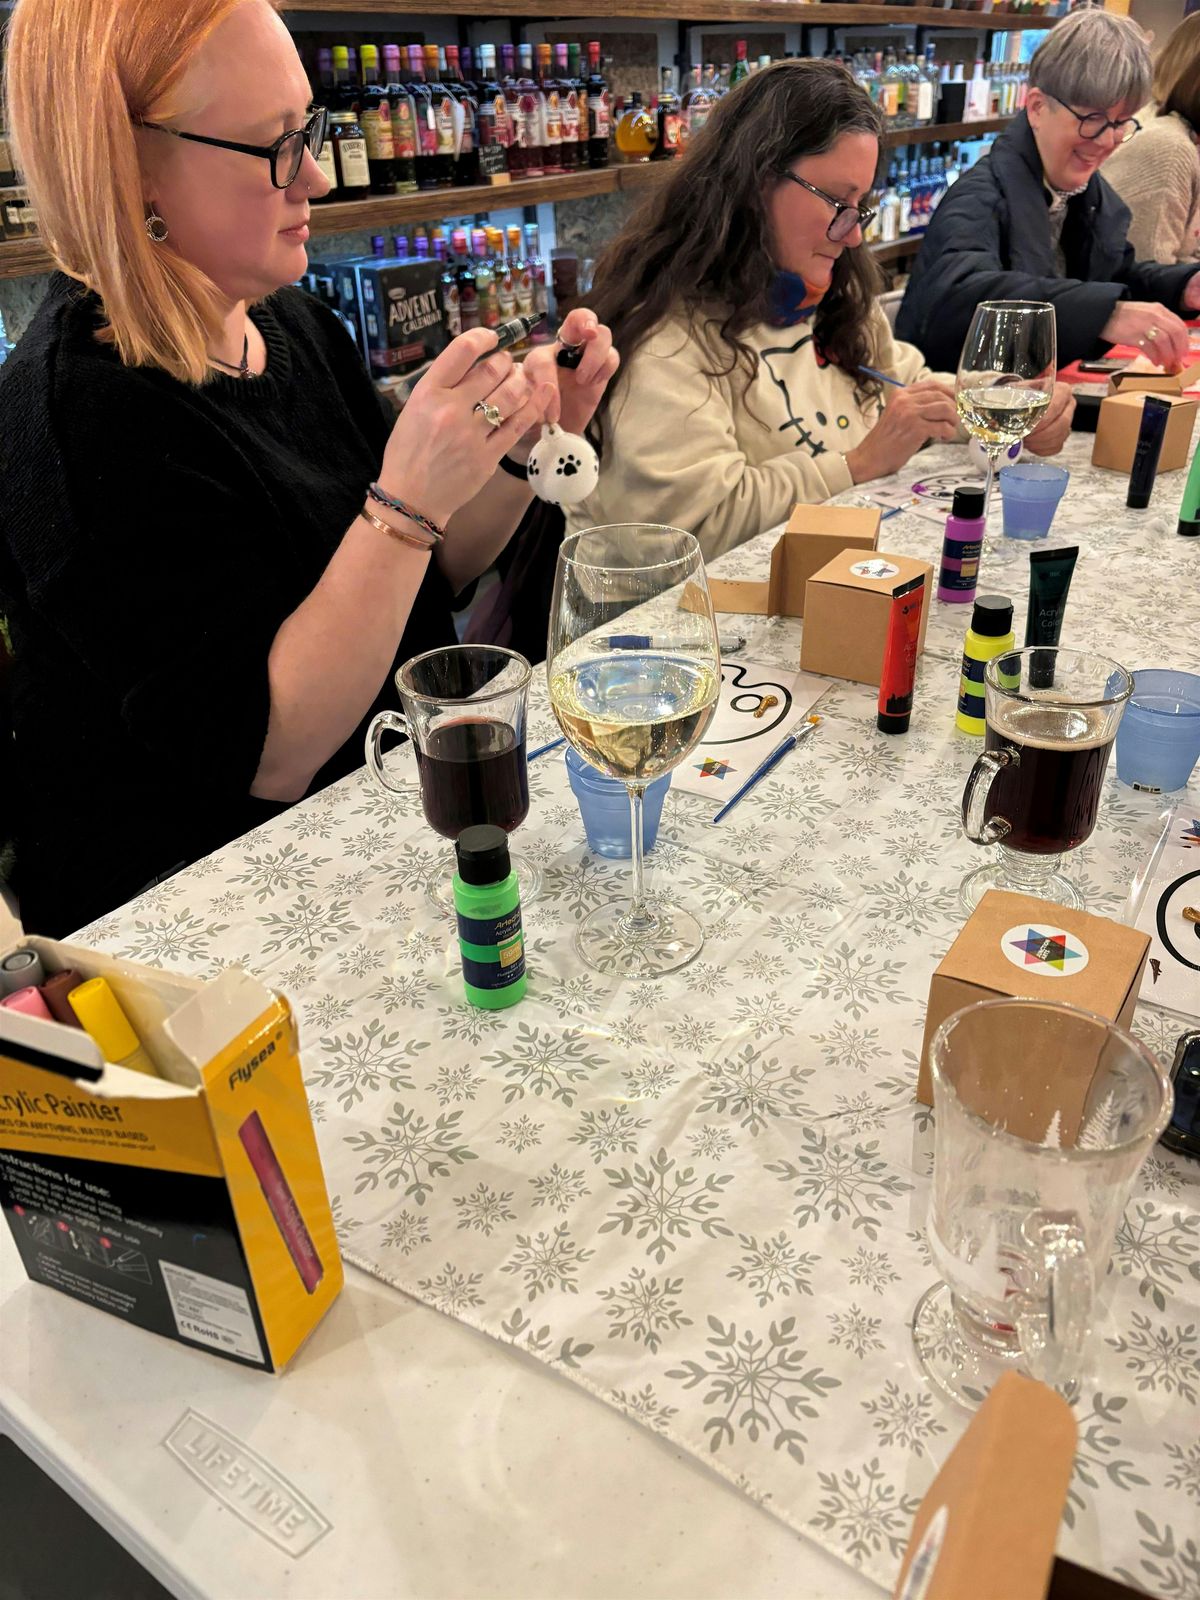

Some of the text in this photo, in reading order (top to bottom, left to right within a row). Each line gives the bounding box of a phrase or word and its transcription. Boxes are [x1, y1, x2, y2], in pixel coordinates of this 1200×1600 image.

[389, 289, 437, 328] ADVENT
[402, 309, 442, 335] CALENDAR
[229, 1041, 276, 1091] Flysea
[44, 1093, 124, 1122] Painter
[64, 1173, 82, 1187] for
[193, 1324, 219, 1340] RoHS
[184, 1432, 310, 1540] LIFETIME
